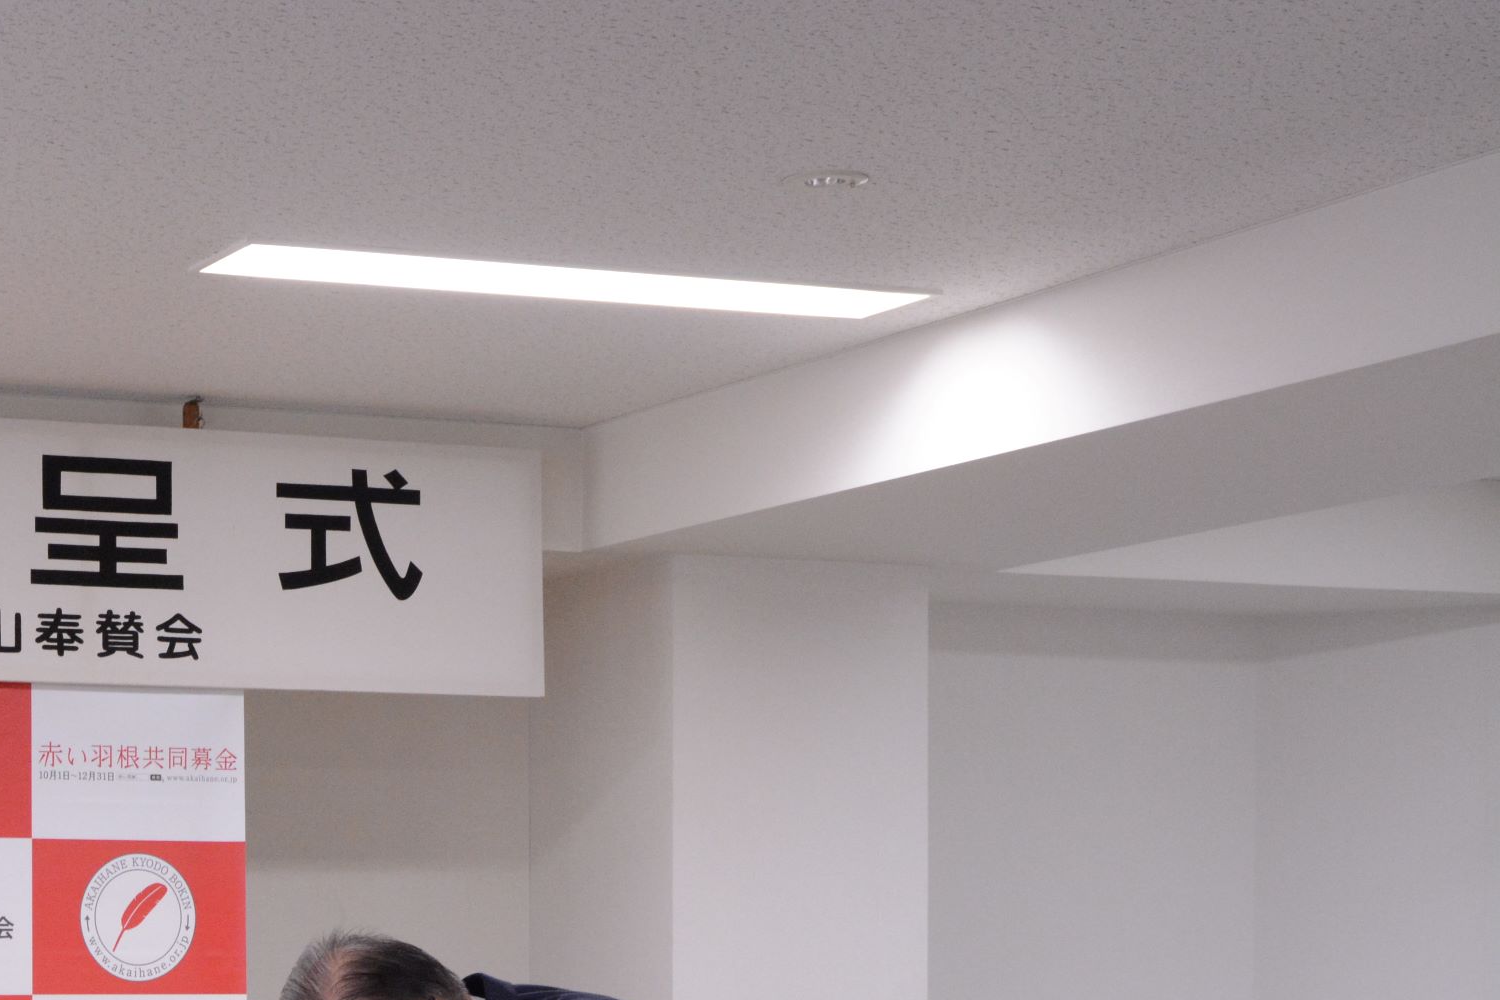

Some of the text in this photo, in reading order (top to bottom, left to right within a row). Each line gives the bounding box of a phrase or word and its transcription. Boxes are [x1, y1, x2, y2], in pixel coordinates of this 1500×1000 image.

[38, 741, 238, 771] 赤い羽根共同募金
[84, 856, 192, 911] AKAIHANE KYODO BOKIN
